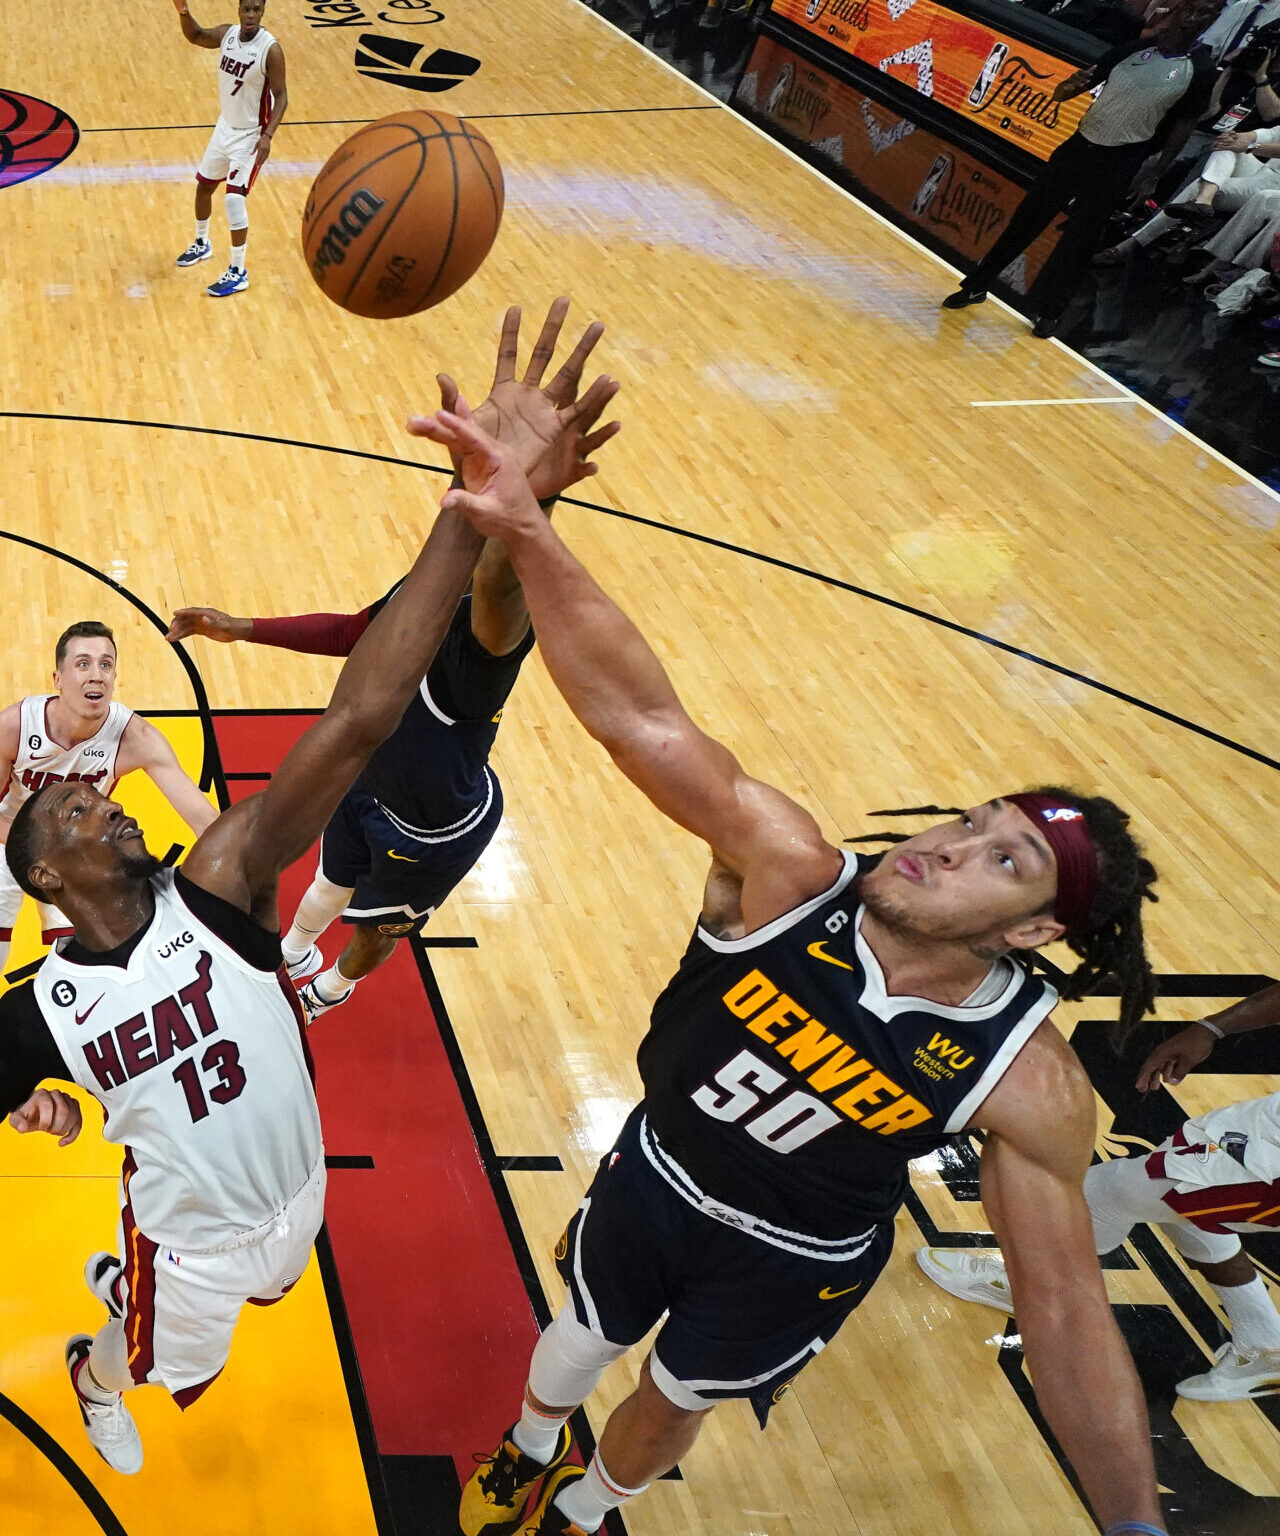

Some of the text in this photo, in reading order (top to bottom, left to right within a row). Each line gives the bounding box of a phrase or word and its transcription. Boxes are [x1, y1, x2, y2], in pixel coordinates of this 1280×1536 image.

[220, 55, 255, 78] HEAT
[230, 80, 244, 96] 7
[30, 736, 40, 749] 6
[824, 909, 849, 934] 6
[53, 982, 74, 1006] 6
[81, 950, 219, 1092] HEAT
[722, 968, 934, 1136] DENVER
[914, 1046, 955, 1080] Western
[926, 1032, 975, 1070] WU
[172, 1039, 247, 1124] 13
[913, 1058, 942, 1083] Union
[690, 1048, 844, 1155] 50
